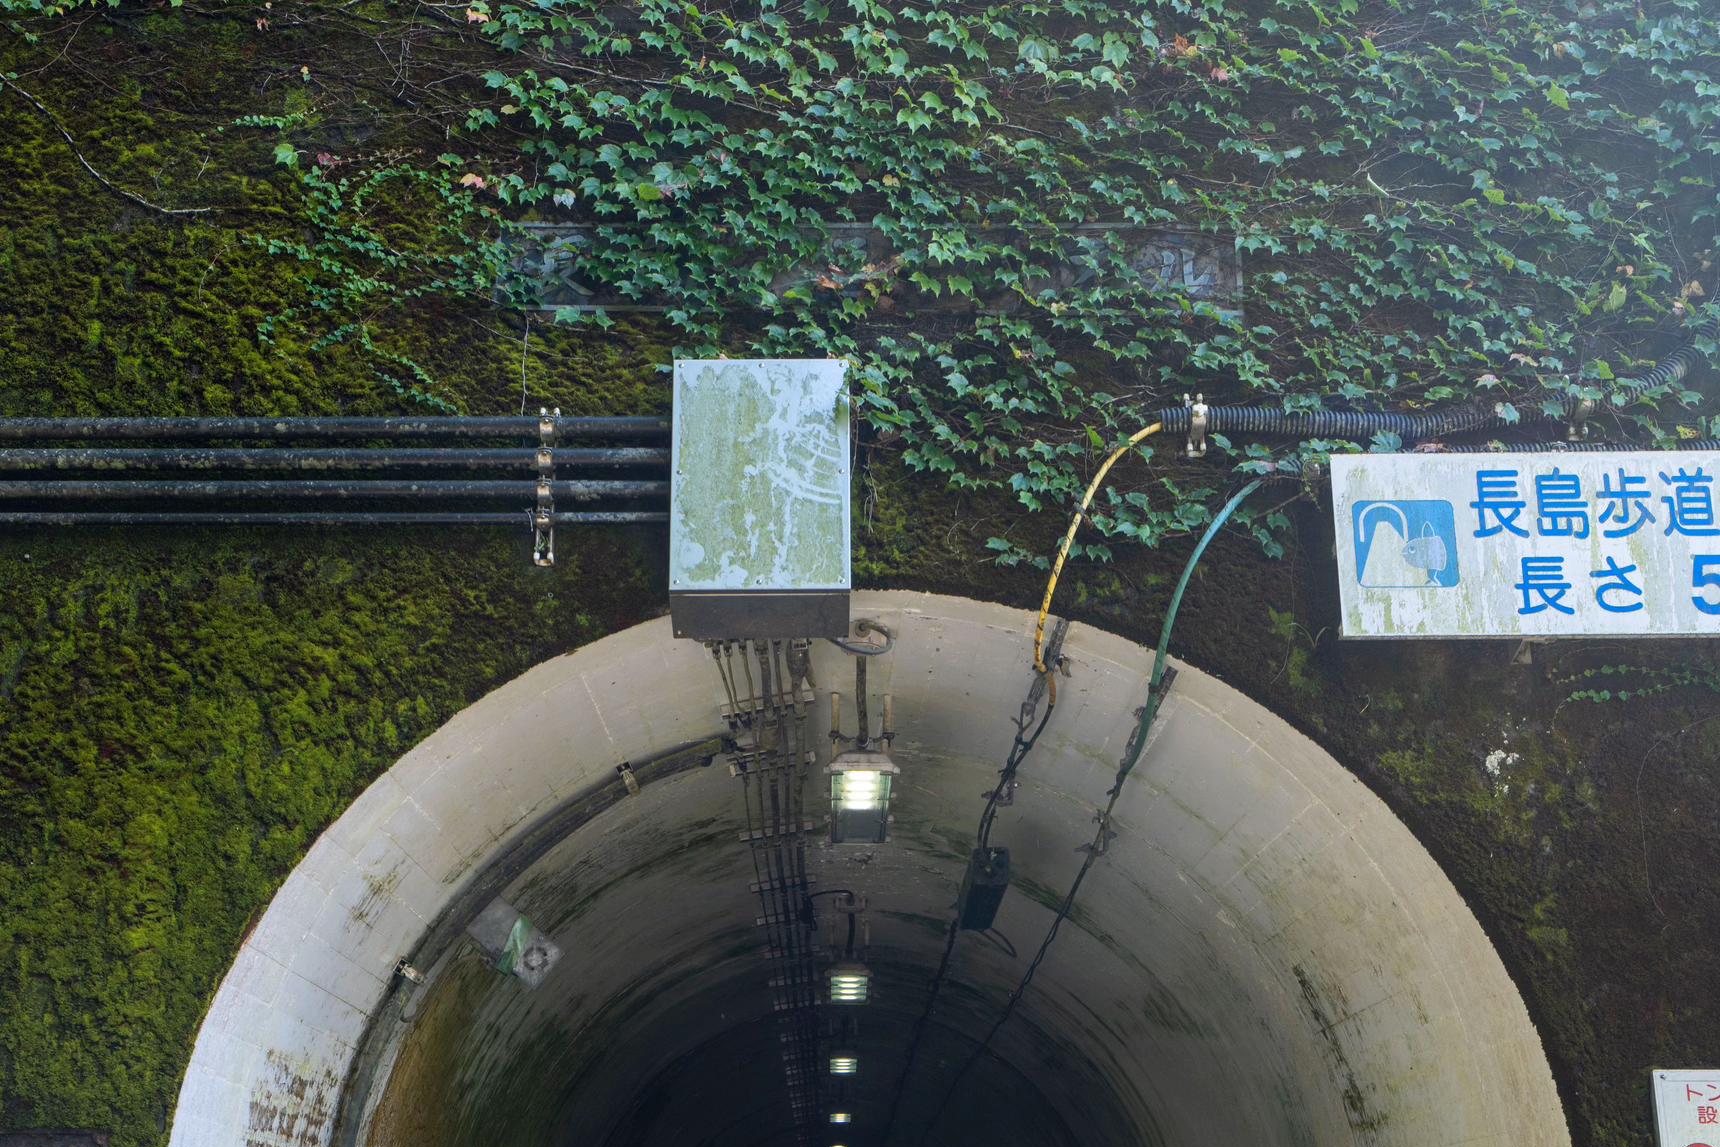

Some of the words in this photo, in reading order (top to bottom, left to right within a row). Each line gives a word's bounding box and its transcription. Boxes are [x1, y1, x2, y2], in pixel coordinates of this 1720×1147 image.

[1470, 467, 1720, 539] 長島歩道
[1514, 556, 1644, 616] 長さ
